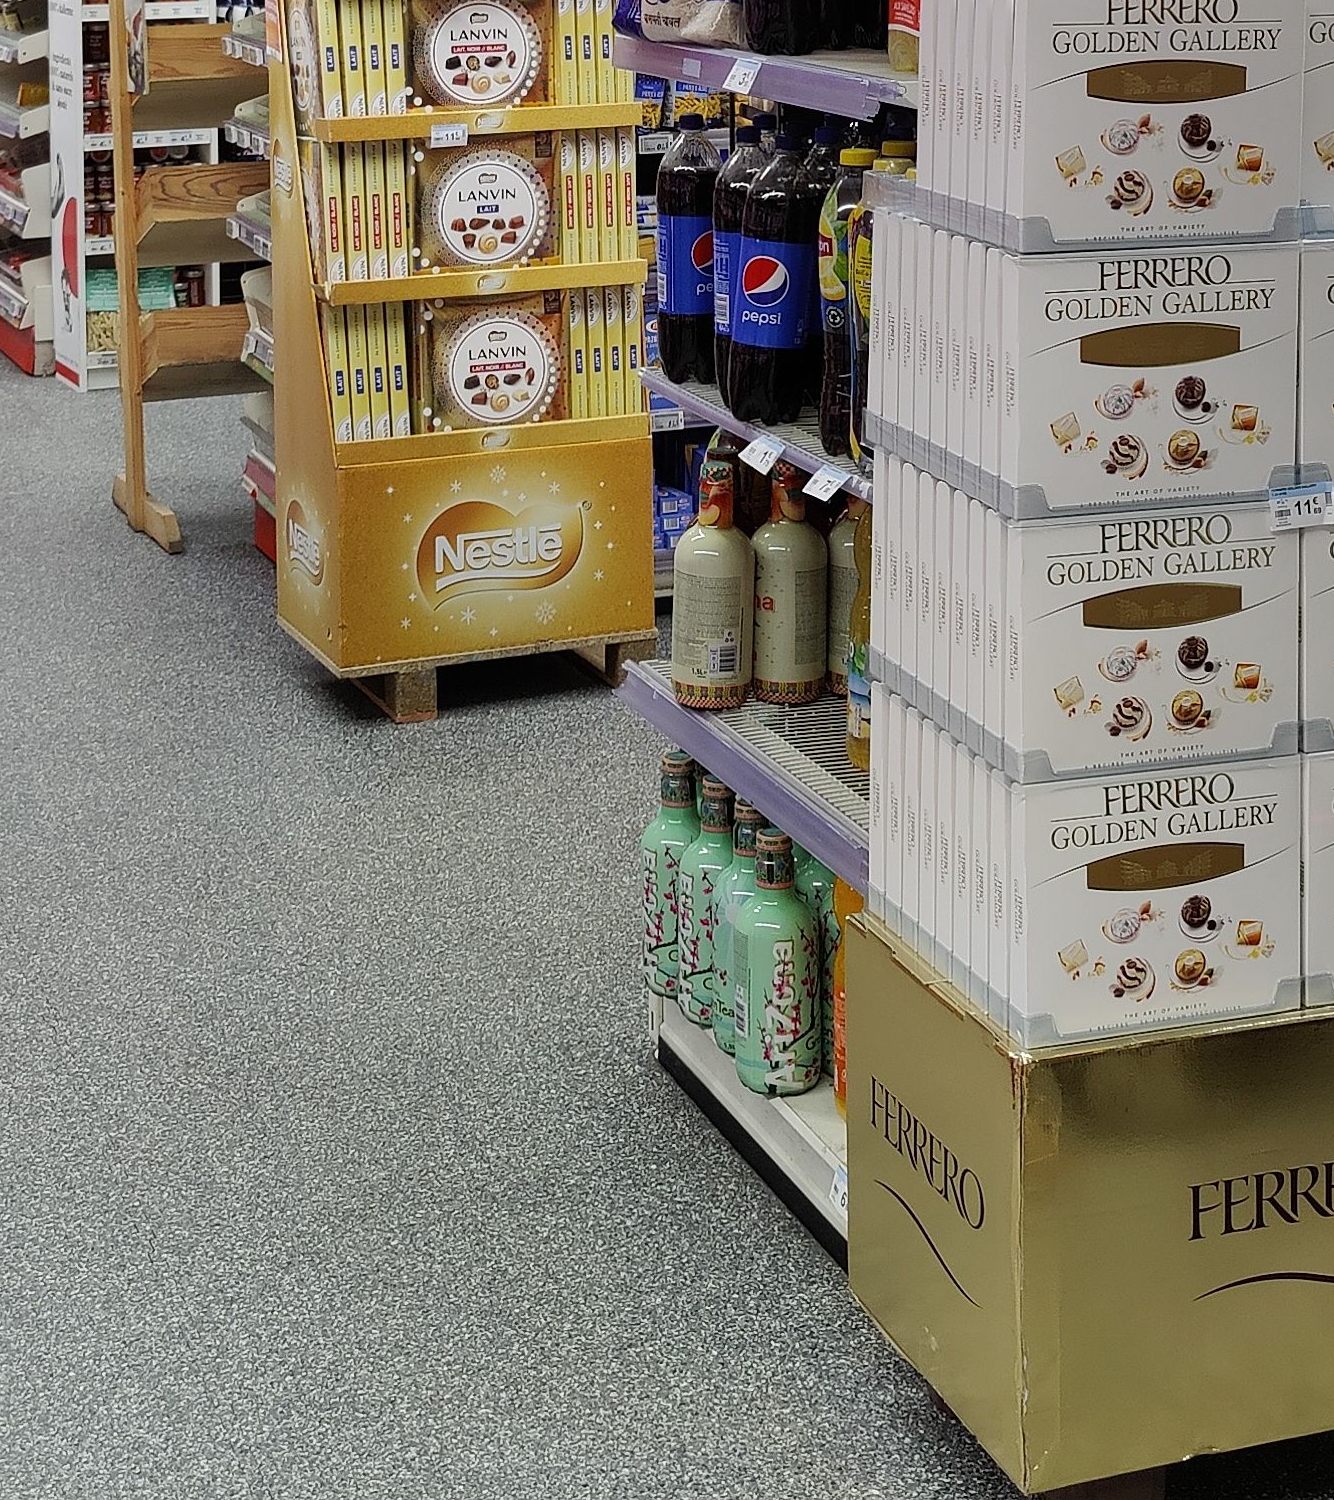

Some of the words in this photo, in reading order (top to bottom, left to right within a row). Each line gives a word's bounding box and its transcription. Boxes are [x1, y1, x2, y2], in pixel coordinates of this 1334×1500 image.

[450, 28, 508, 41] LANVIN
[1053, 29, 1163, 55] GOLDEN
[1169, 26, 1282, 53] GALLERY
[458, 187, 516, 202] LANVIN
[1098, 254, 1232, 291] FERRERO
[742, 310, 783, 326] pepsi
[1044, 296, 1154, 322] GOLDEN
[1161, 286, 1276, 315] GALLERY
[468, 345, 527, 361] LANVIN
[1099, 514, 1233, 554] FERRERO
[1047, 556, 1154, 586] GOLDEN
[1161, 545, 1276, 576] GALLERY
[1102, 772, 1235, 818] FERRERO
[1051, 820, 1158, 851] GOLDEN
[1167, 803, 1278, 836] GALLERY
[869, 1074, 986, 1230] FERRERO
